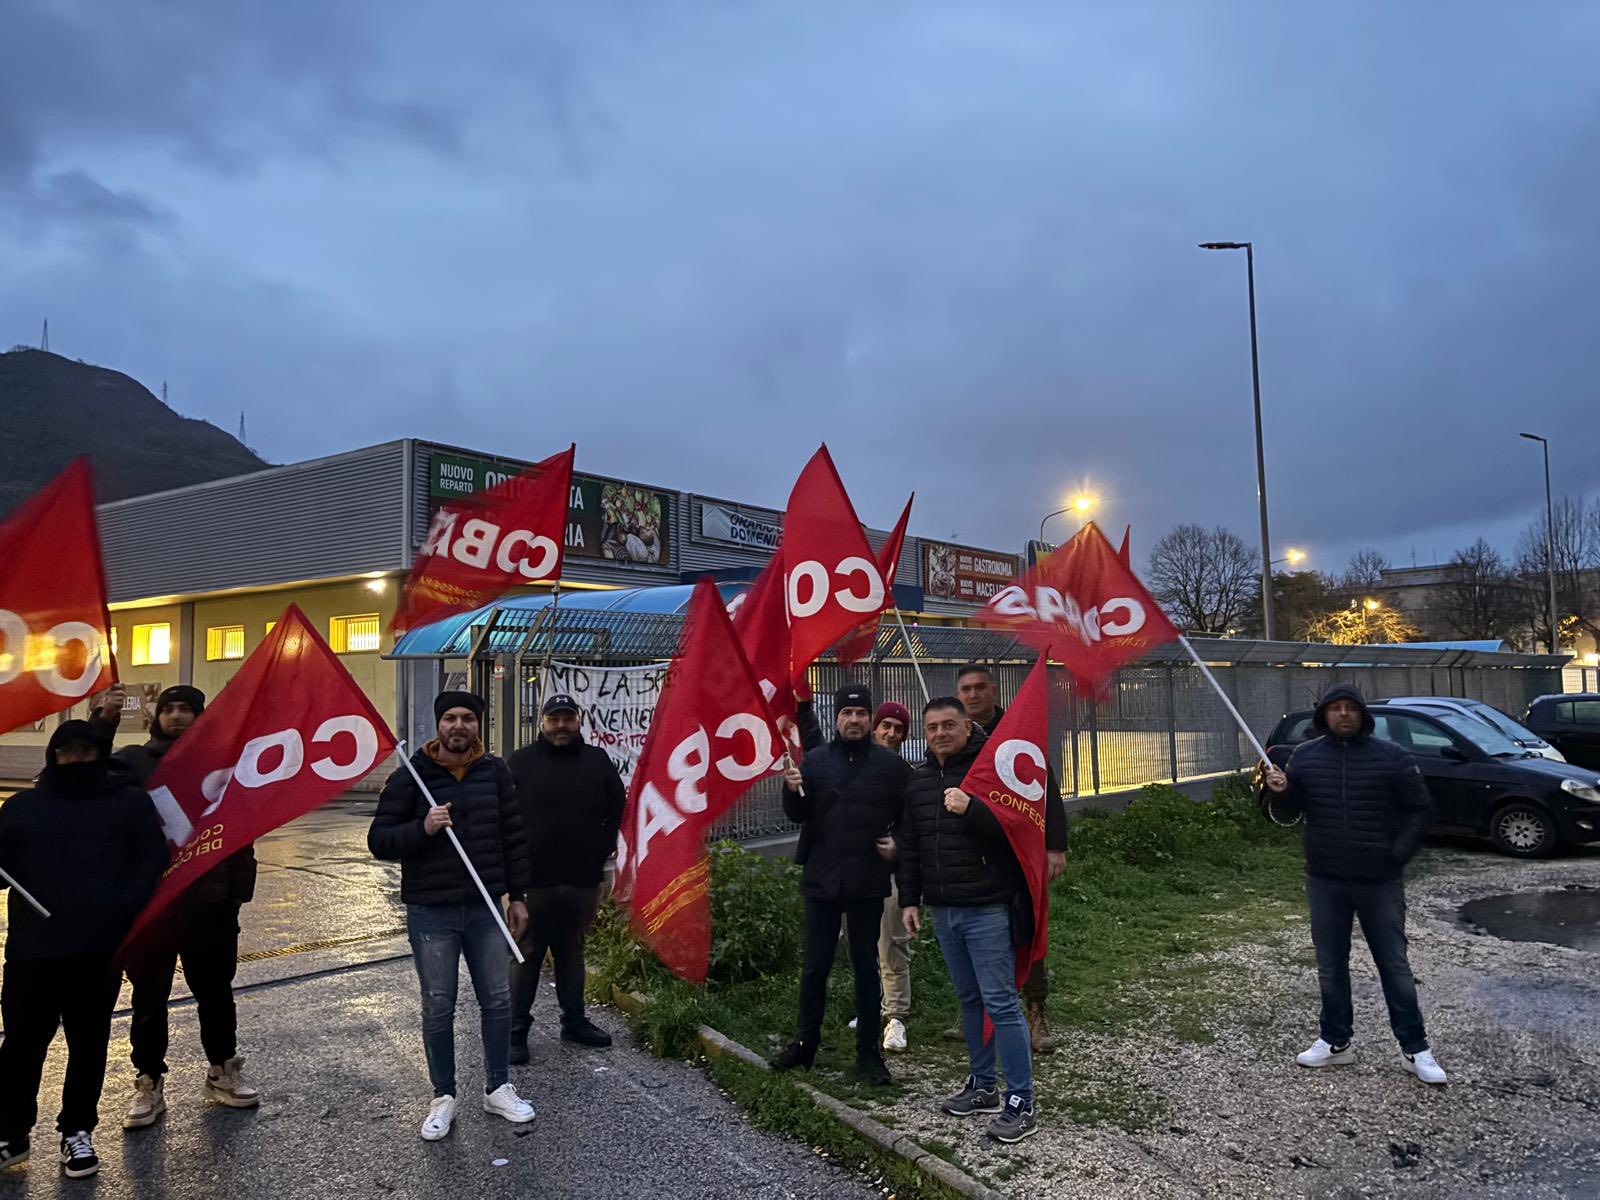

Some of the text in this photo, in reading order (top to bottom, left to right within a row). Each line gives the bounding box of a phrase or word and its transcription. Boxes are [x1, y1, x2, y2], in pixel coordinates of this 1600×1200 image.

[440, 463, 474, 481] NUOVO
[440, 479, 474, 493] REPARTO
[974, 557, 1012, 576] GASTRONOMIA
[550, 664, 590, 694] MD
[598, 671, 631, 701] LA
[995, 738, 1048, 805] C
